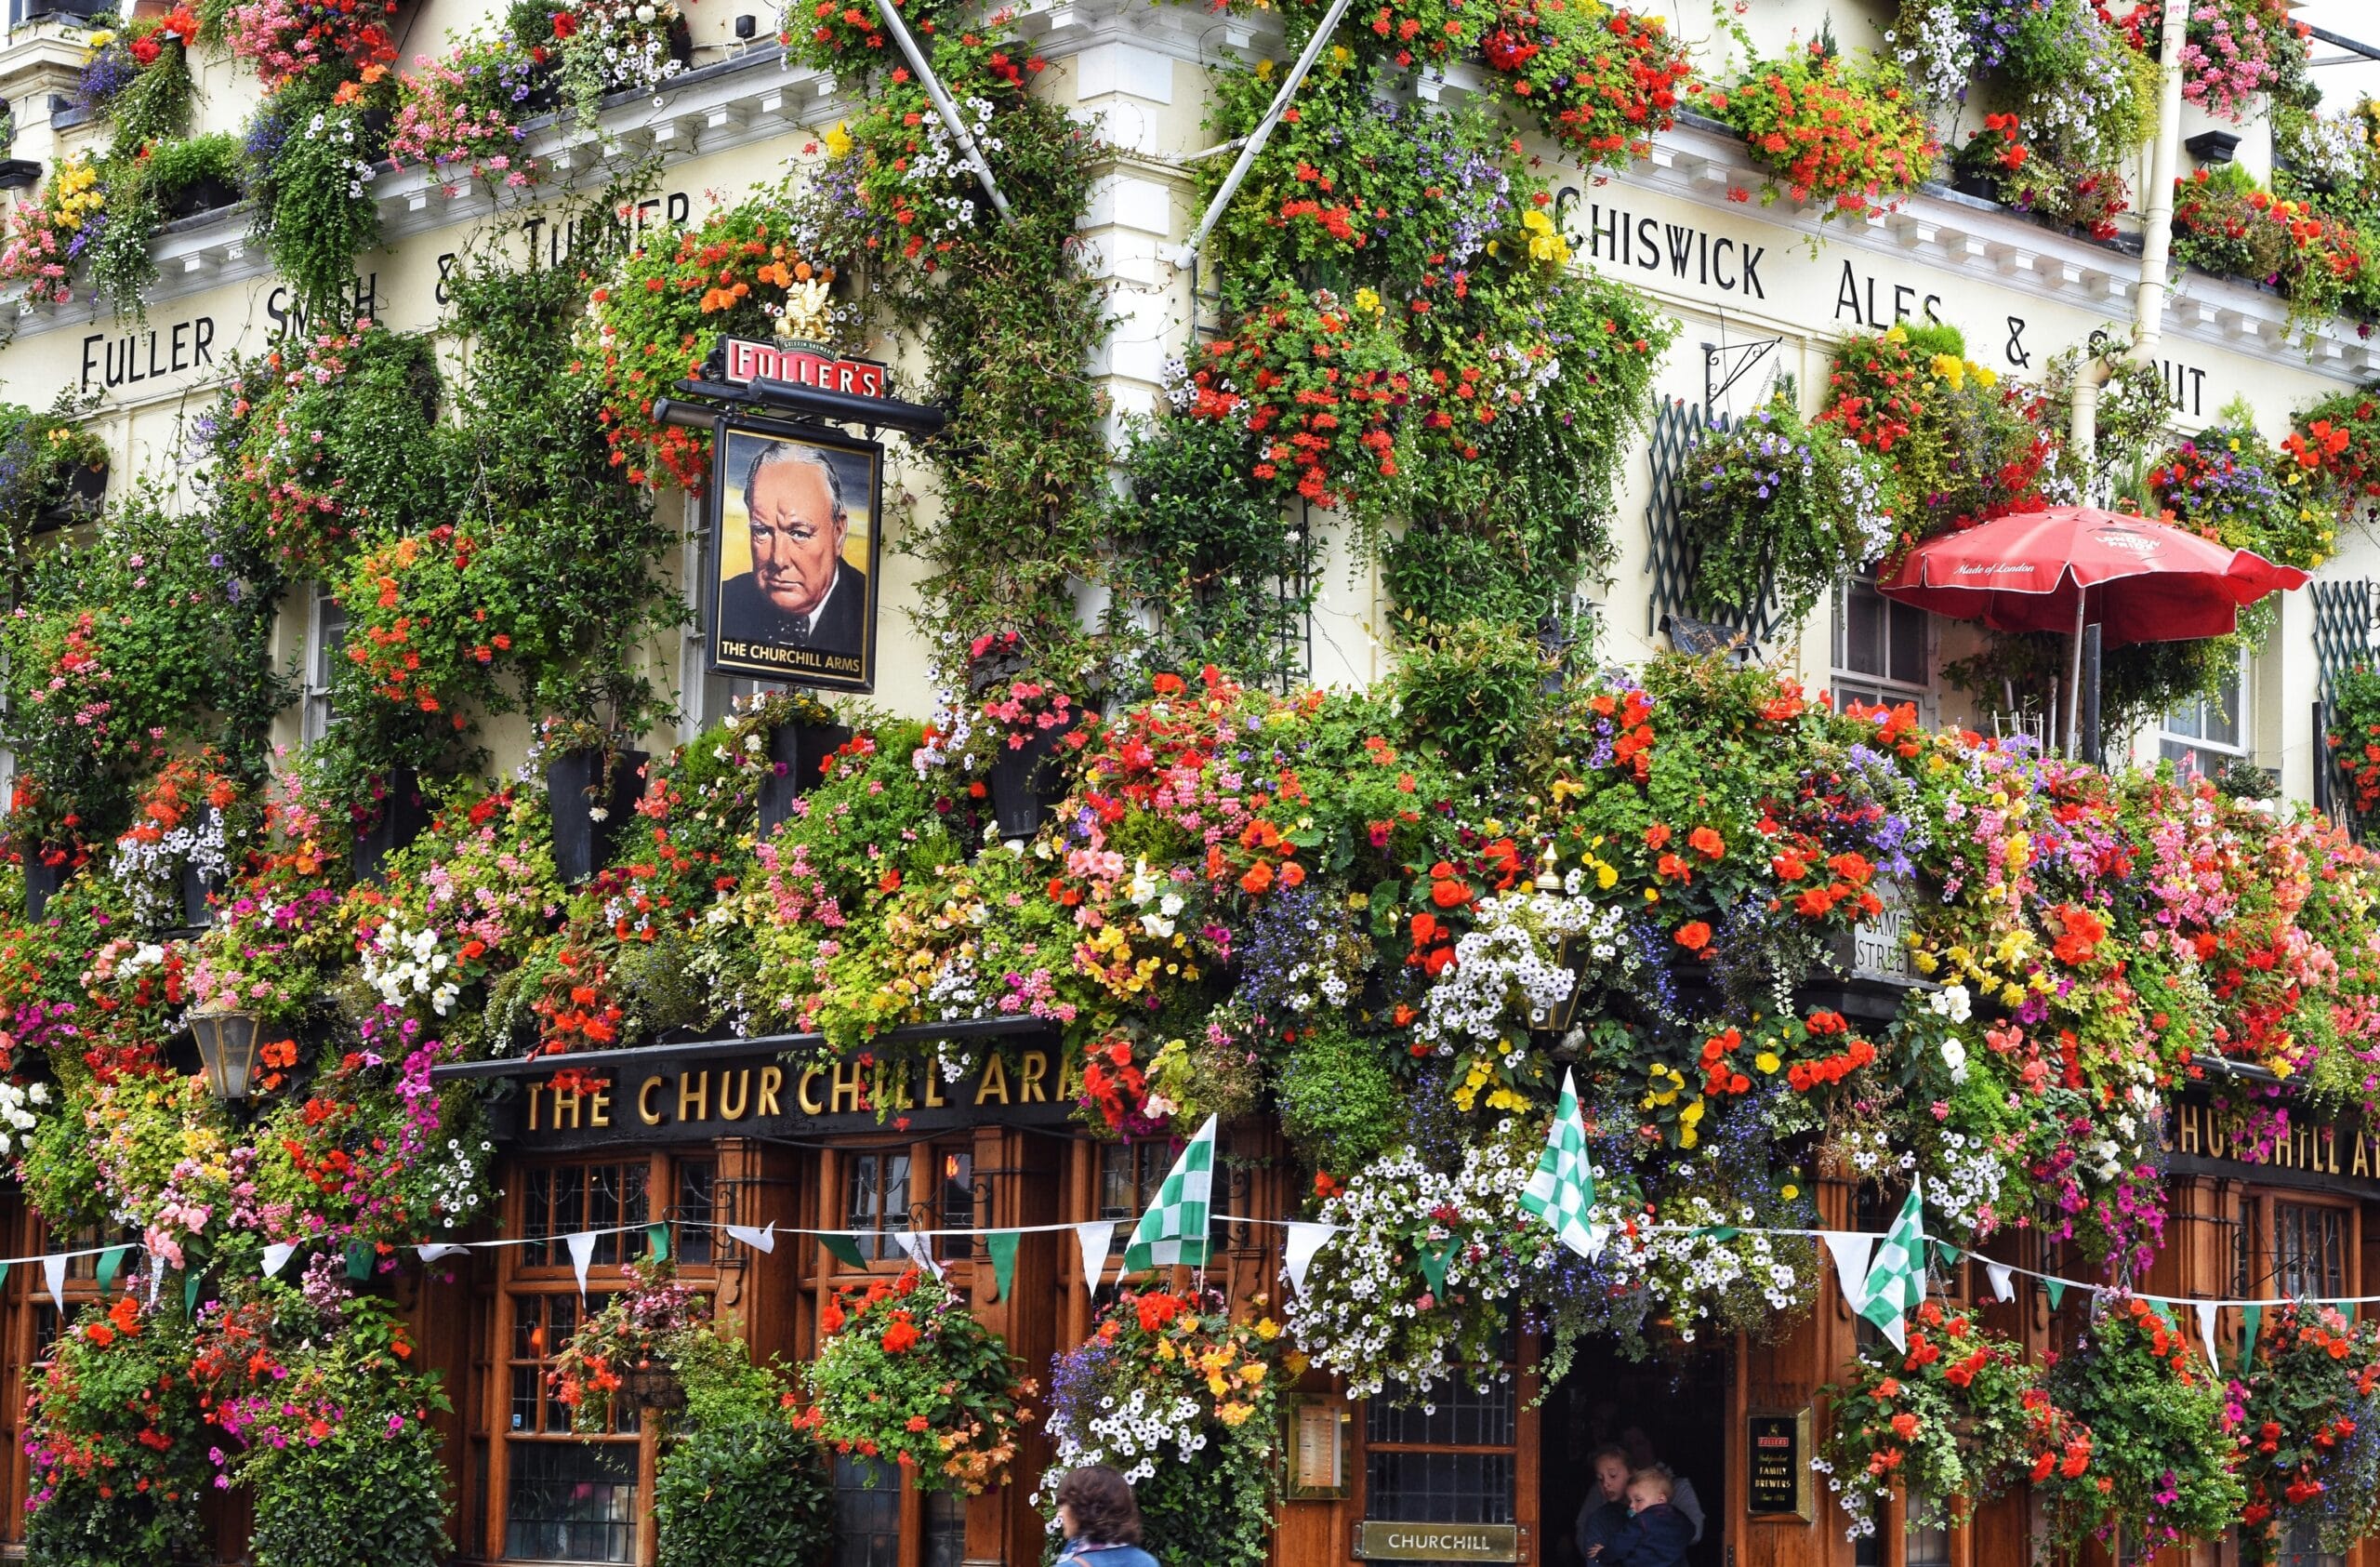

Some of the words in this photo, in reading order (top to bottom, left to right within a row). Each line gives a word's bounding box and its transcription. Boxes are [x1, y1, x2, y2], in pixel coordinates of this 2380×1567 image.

[1554, 186, 1765, 299] CHISWICK
[1834, 259, 1942, 331] ALES
[2005, 315, 2031, 369] &
[81, 316, 214, 394] FULLER
[266, 272, 377, 347] SMH
[434, 252, 456, 306] &
[737, 343, 877, 398] FULLER'S
[1953, 564, 1984, 575] Made
[1984, 563, 1996, 577] of
[1993, 562, 2035, 573] London
[721, 641, 747, 657] THE
[749, 644, 822, 668] CHURCHILL
[825, 656, 861, 672] ARMS
[526, 1077, 611, 1131] THE
[638, 1056, 945, 1126] CHURCHILL
[974, 1050, 1077, 1105] AR
[1754, 1480, 1792, 1488] BREWERS
[1759, 1467, 1787, 1475] FAMILY
[1388, 1534, 1491, 1551] CHURCHILL
